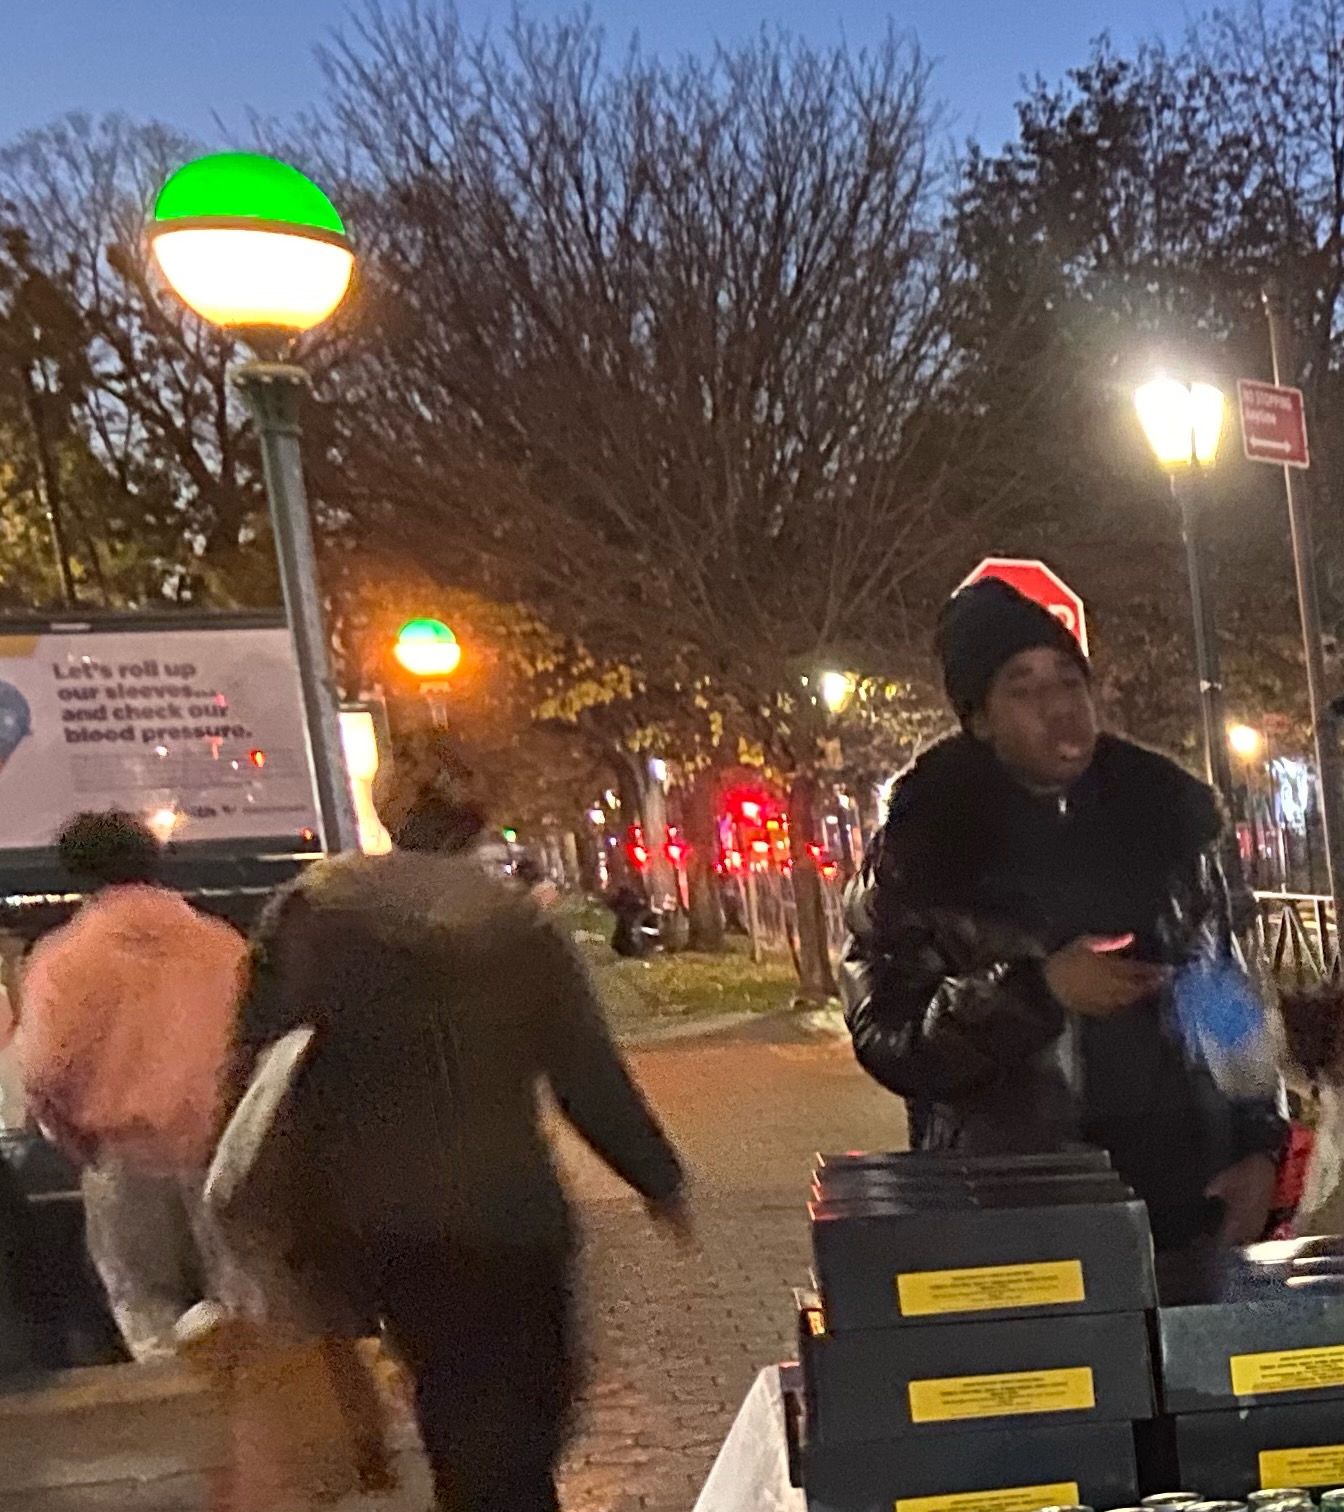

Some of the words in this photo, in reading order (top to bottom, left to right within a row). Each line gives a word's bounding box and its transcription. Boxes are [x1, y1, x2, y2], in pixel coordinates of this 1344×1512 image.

[53, 661, 112, 679] Let's
[119, 660, 159, 679] roll
[164, 663, 197, 679] up
[57, 686, 99, 700] our
[62, 704, 107, 721] and
[112, 703, 183, 720] check
[188, 704, 228, 718] our
[64, 725, 135, 743] blood
[141, 725, 252, 743] pressure.
